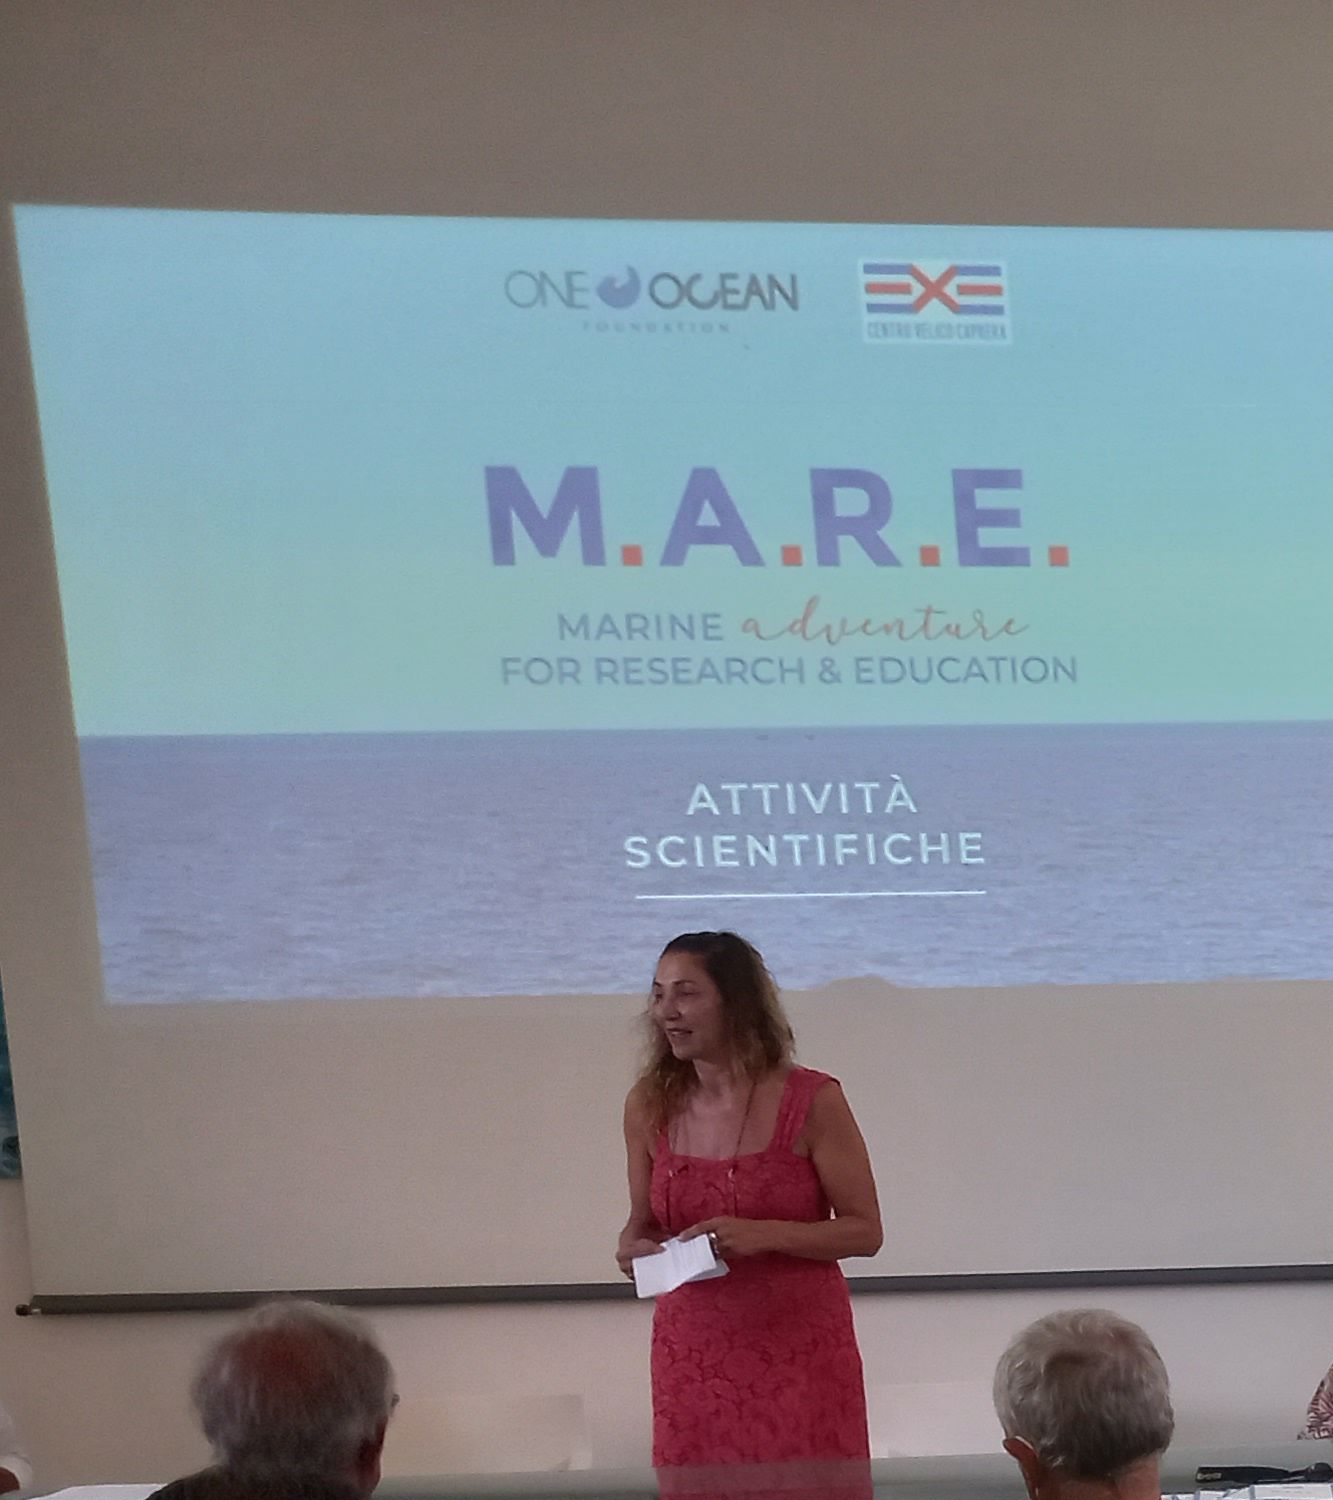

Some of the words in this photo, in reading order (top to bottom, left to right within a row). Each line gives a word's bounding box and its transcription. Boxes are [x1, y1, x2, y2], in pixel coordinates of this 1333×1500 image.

[504, 270, 589, 310] ONE
[649, 271, 800, 312] OCEAN
[581, 321, 730, 334] FOUNDATION
[484, 465, 1069, 568] M.A.R.E.
[557, 612, 723, 643] MARINE
[741, 595, 1029, 645] adventure
[501, 656, 582, 686] FOR
[597, 656, 805, 686] RESEARCH
[818, 656, 842, 686] &
[855, 656, 1078, 685] EDUCATION
[686, 774, 917, 816] ATTIVITÀ
[623, 832, 985, 869] SCIENTIFICHE
